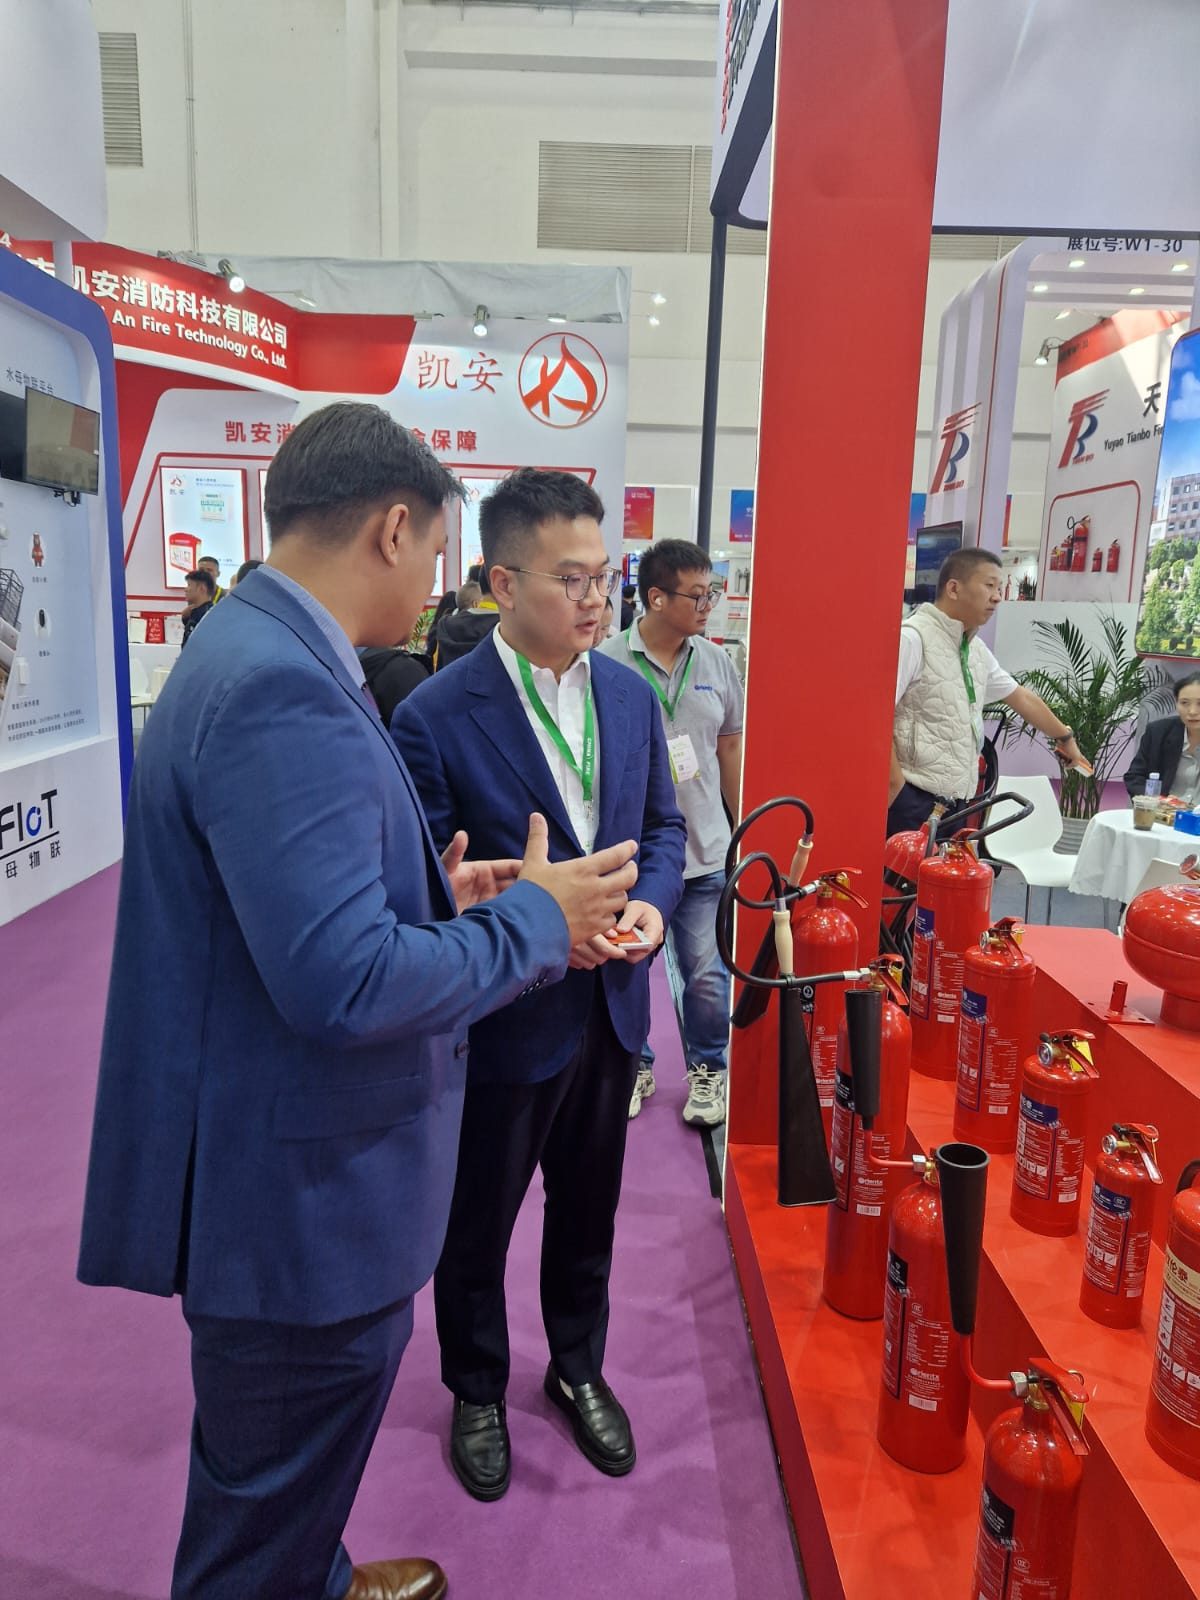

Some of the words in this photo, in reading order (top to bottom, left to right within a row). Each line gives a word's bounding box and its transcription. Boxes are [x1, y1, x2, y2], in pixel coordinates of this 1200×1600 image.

[112, 309, 136, 328] An
[142, 315, 171, 335] Fire
[175, 323, 248, 358] Technology
[418, 350, 503, 394] 凯安
[1143, 381, 1161, 418] 天
[1104, 438, 1124, 452] Yuyao
[1127, 429, 1151, 445] Tianbo
[6, 840, 61, 879] 母物联
